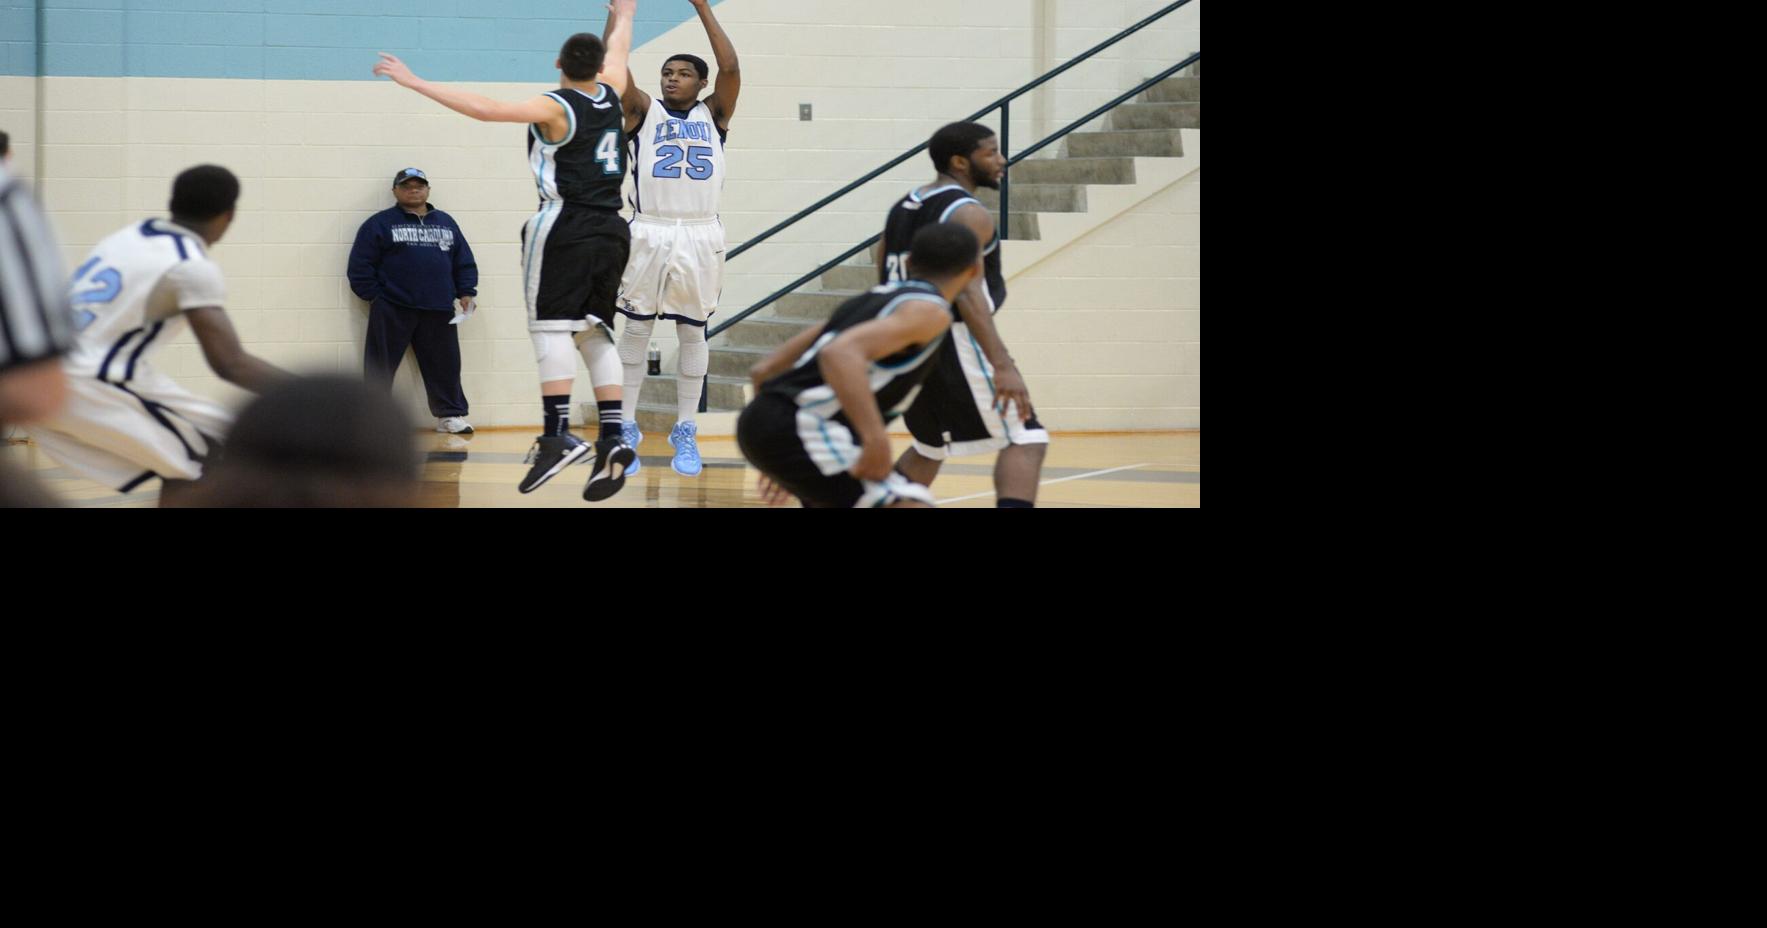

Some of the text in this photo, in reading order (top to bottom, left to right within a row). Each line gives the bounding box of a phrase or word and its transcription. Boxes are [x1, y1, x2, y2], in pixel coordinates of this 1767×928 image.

[653, 119, 712, 144] LENOI
[594, 129, 621, 174] 4
[652, 144, 714, 181] 25
[391, 228, 419, 242] NORTH
